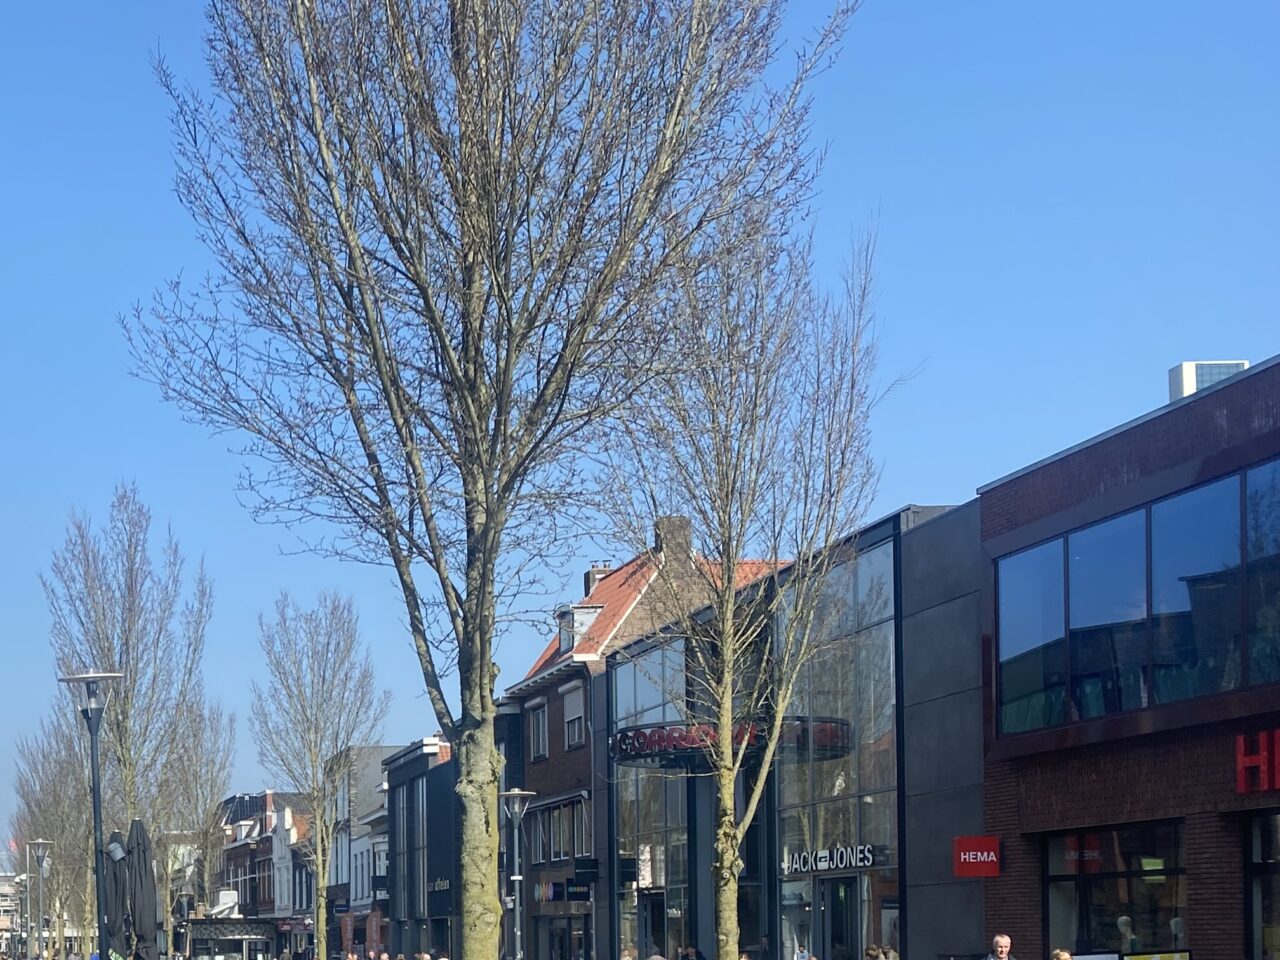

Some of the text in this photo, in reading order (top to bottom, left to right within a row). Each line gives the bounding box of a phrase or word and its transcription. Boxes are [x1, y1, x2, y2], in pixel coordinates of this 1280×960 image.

[1235, 728, 1280, 794] H
[787, 851, 816, 873] JACK
[830, 844, 873, 869] JONES
[960, 851, 997, 863] HEMA
